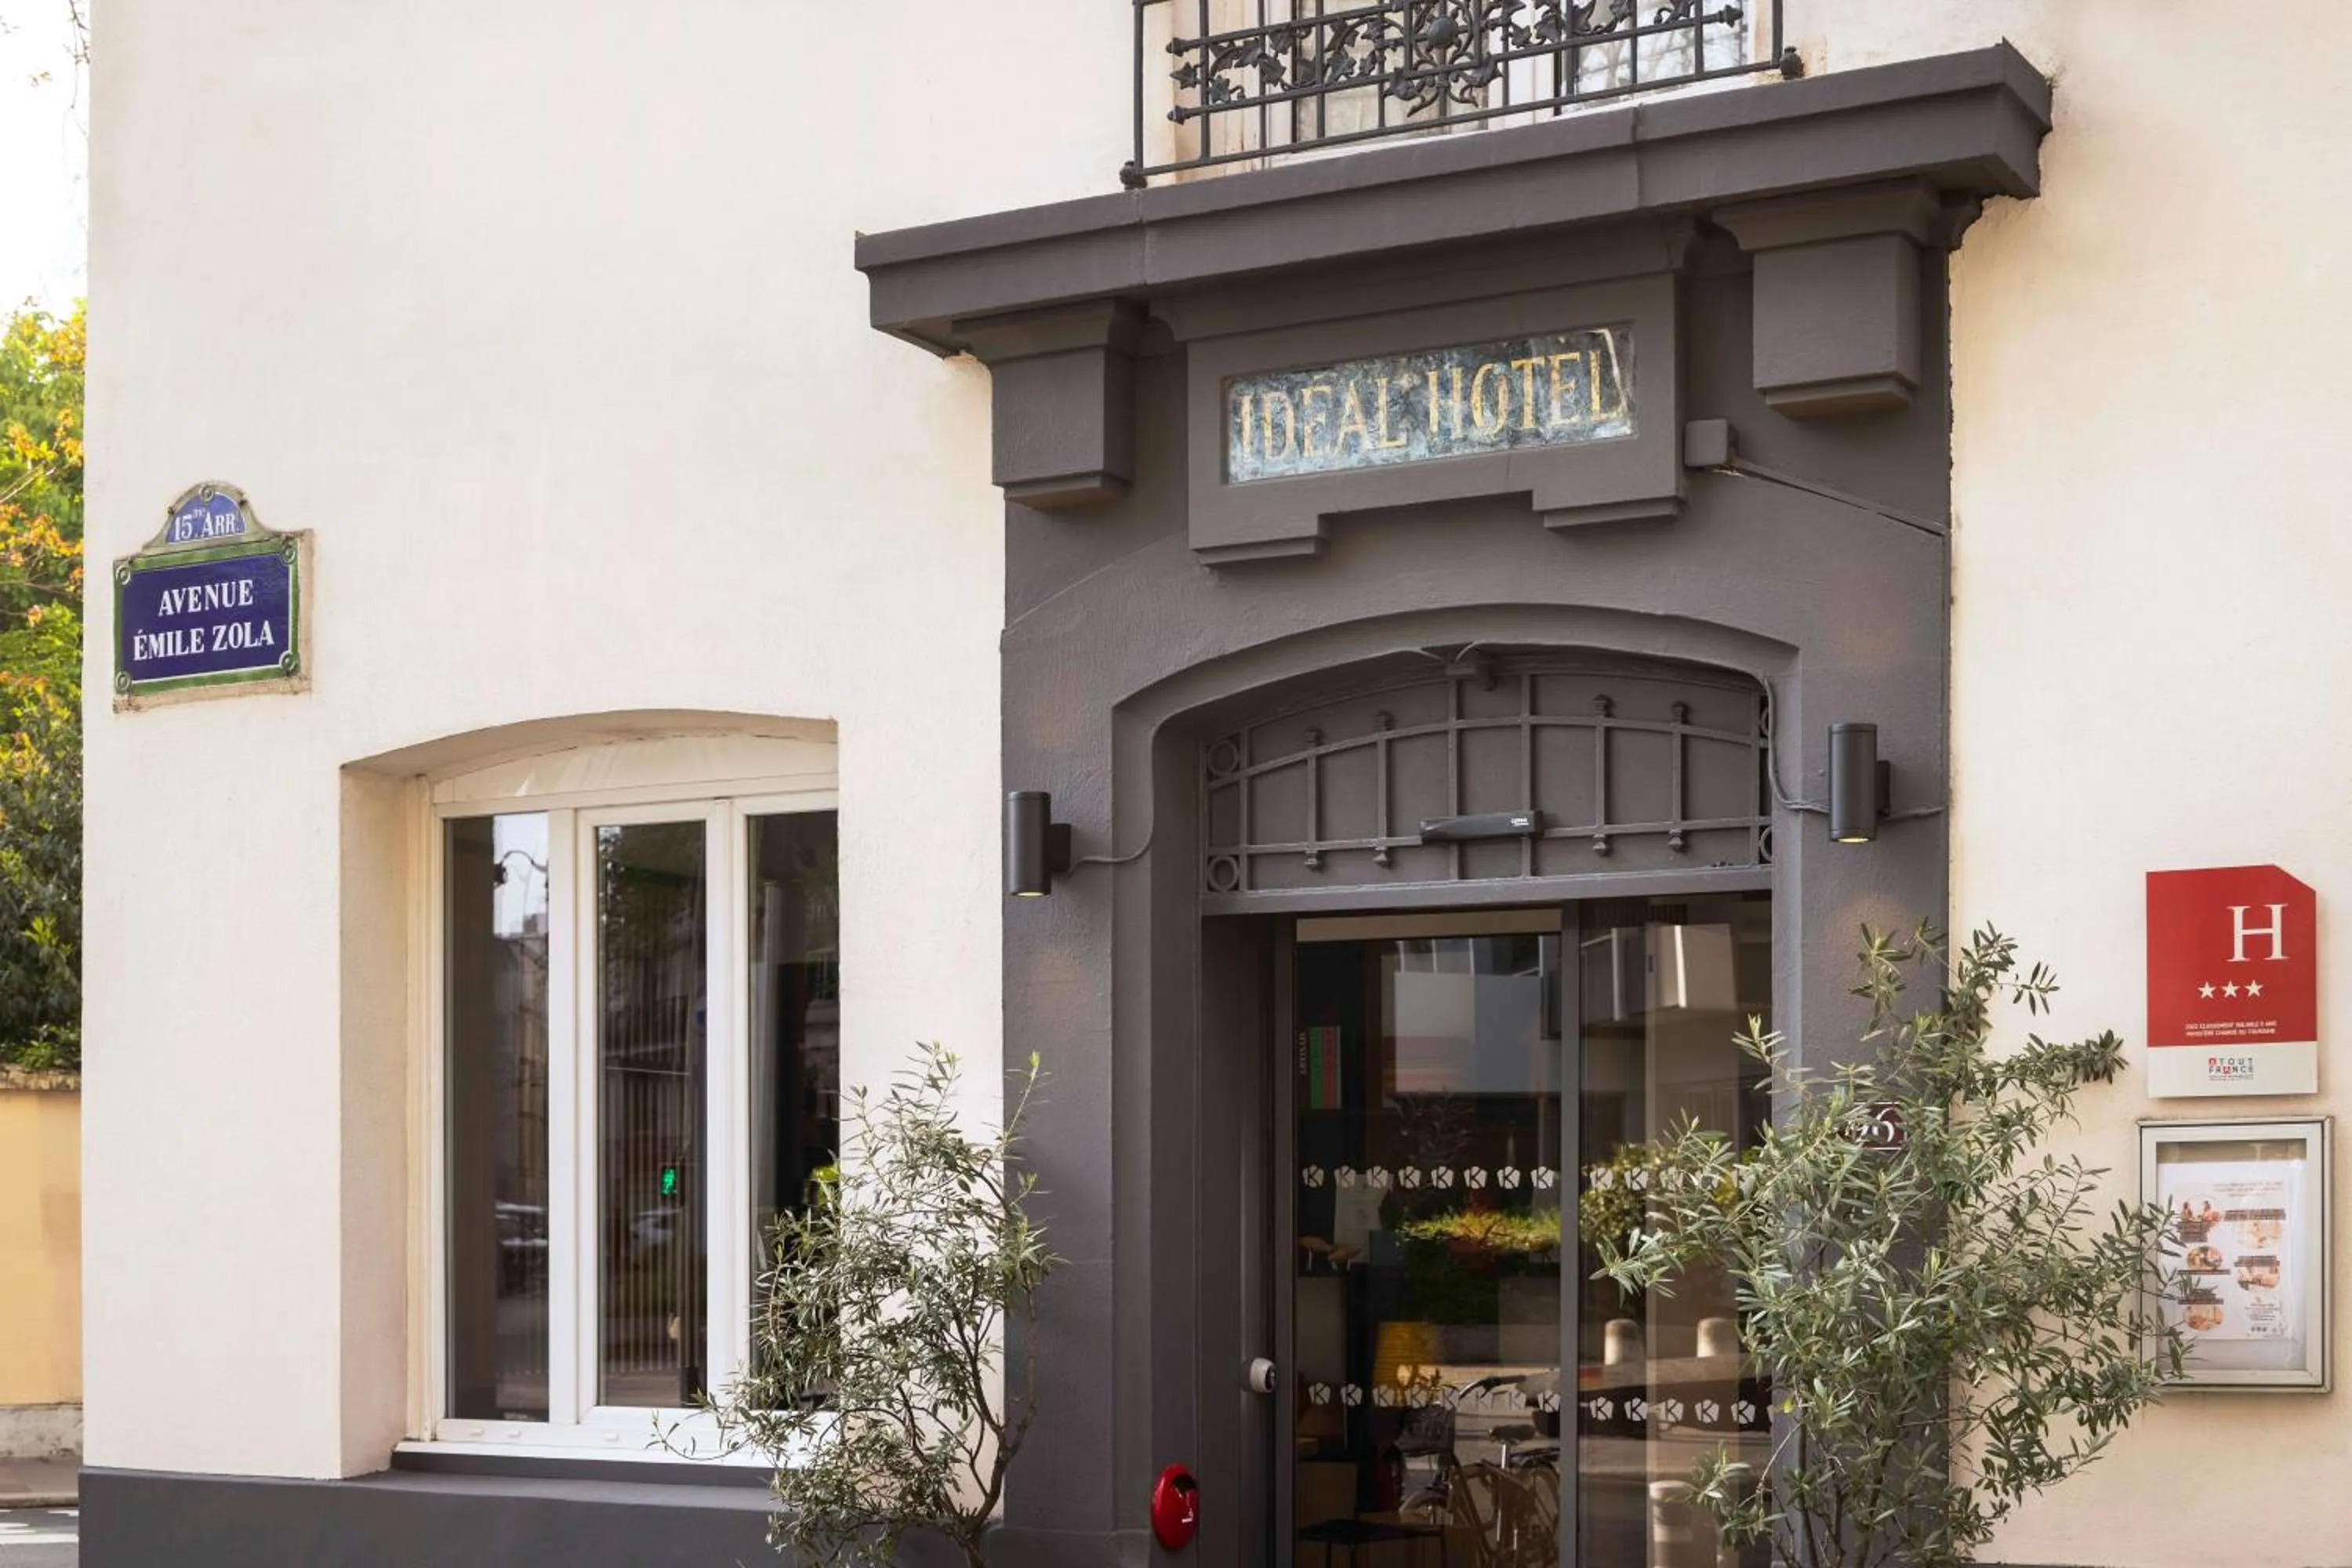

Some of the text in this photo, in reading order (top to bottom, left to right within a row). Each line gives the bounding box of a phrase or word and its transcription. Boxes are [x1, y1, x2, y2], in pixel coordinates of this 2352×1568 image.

[1427, 350, 1628, 439] HOTEL
[158, 579, 253, 616] AVENUE
[133, 619, 274, 660] ÉMILE ZOLA
[2225, 902, 2290, 963] H
